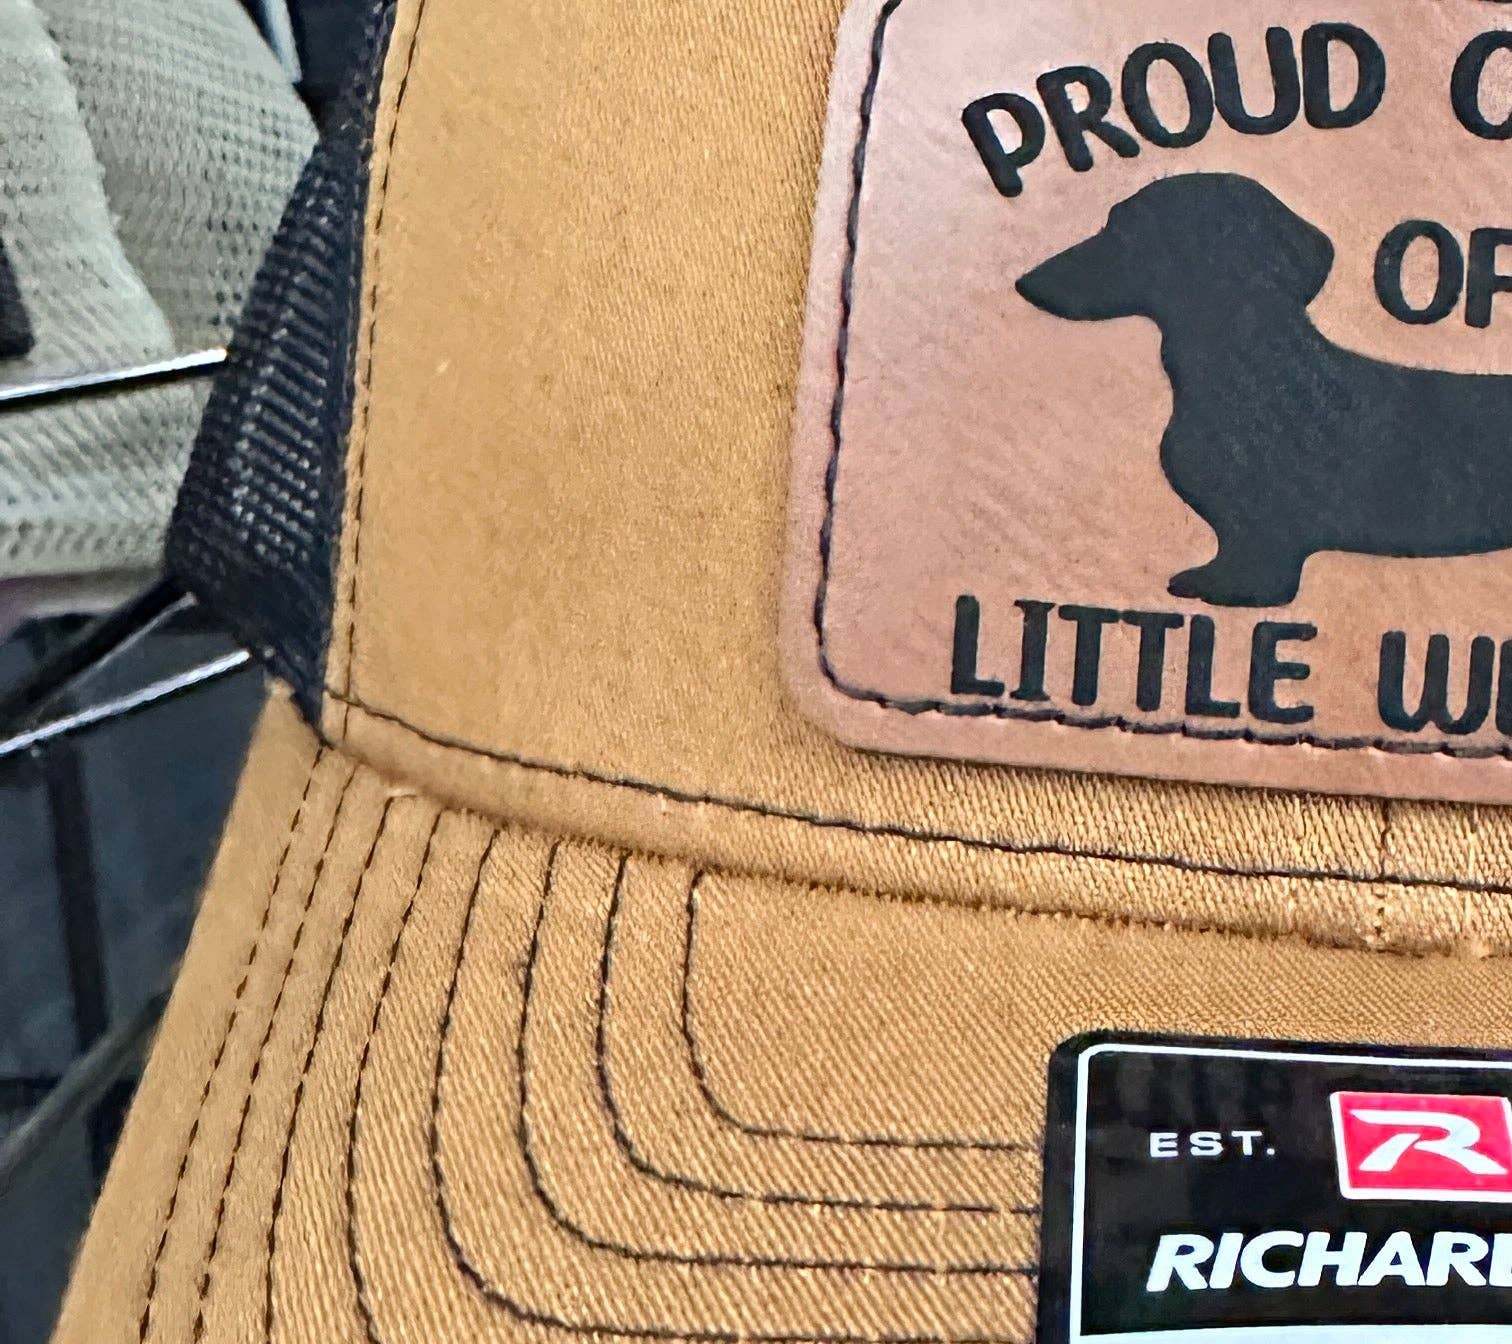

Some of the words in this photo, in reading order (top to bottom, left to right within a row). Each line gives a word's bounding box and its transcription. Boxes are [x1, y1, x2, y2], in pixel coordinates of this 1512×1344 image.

[961, 22, 1386, 198] PROUD
[950, 594, 1318, 725] LITTLE
[1149, 1130, 1276, 1158] EST.
